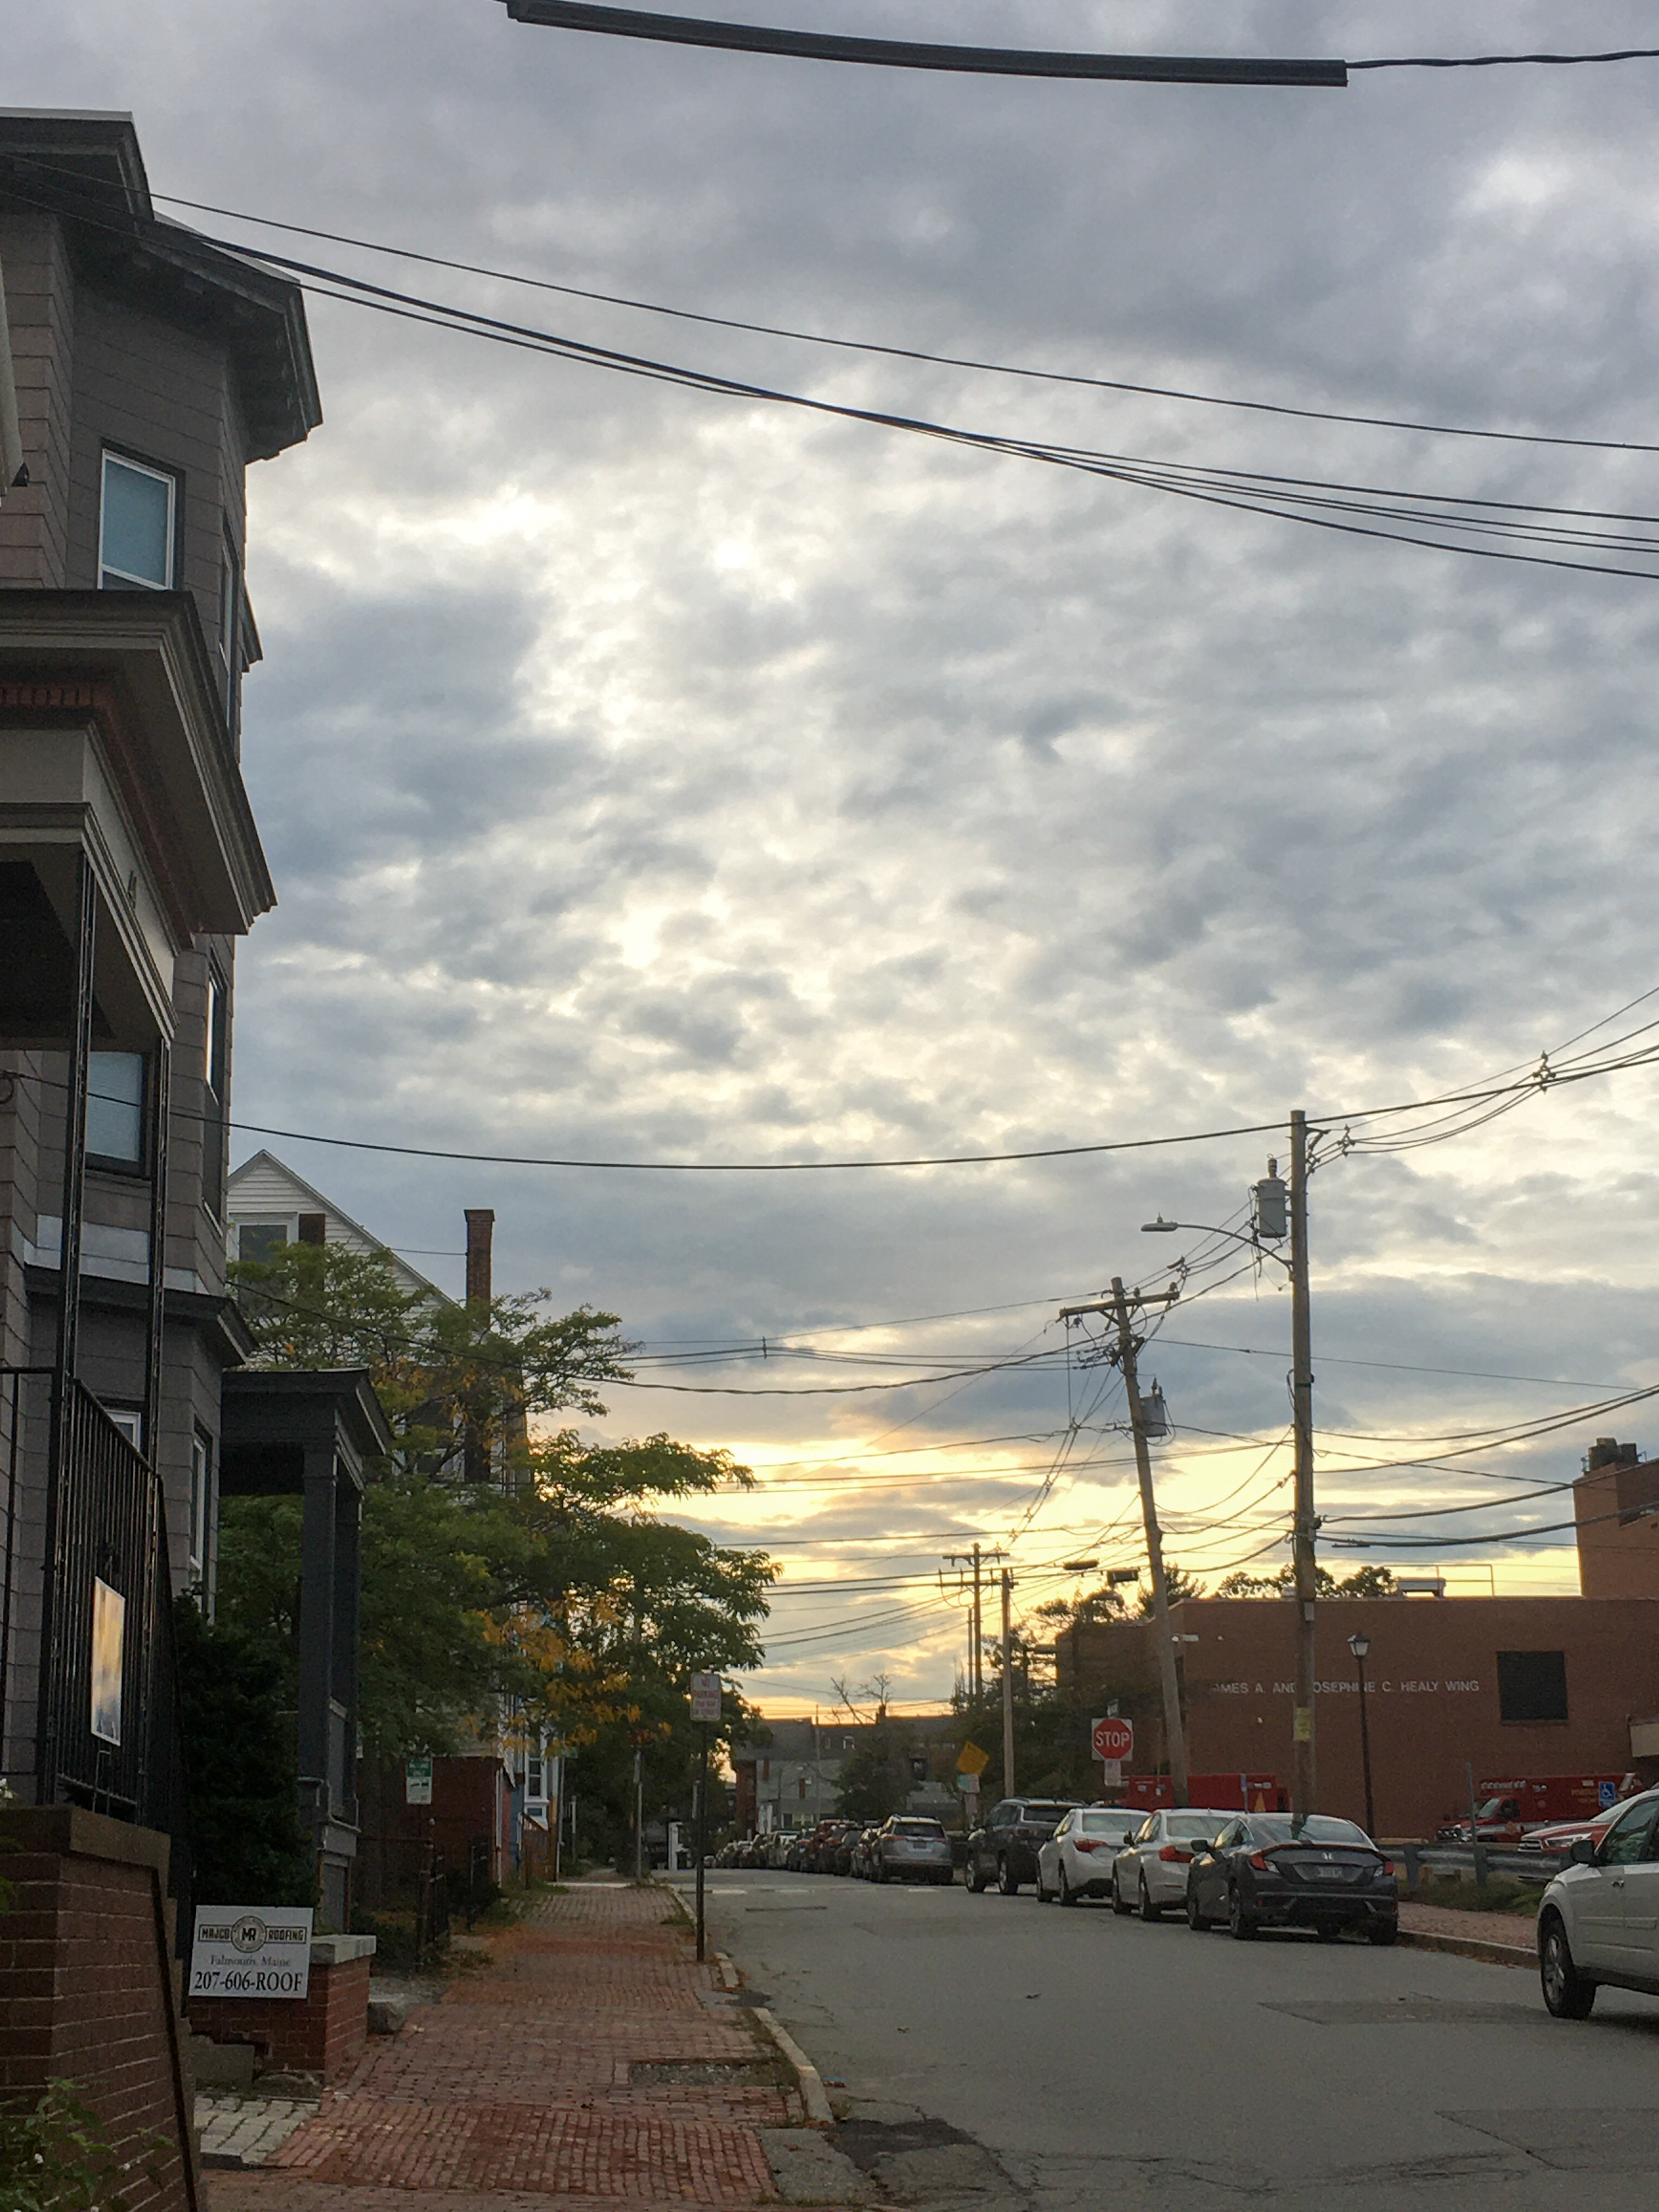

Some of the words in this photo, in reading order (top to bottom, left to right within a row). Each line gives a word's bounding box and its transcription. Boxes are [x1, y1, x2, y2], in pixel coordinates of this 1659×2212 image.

[1209, 1681, 1249, 1694] AMES
[1401, 1680, 1439, 1692] HEALY
[1445, 1679, 1480, 1692] WING
[1096, 1731, 1130, 1747] STOP
[268, 1929, 304, 1941] ROOFING
[194, 1970, 303, 1992] 207-606-ROOF
